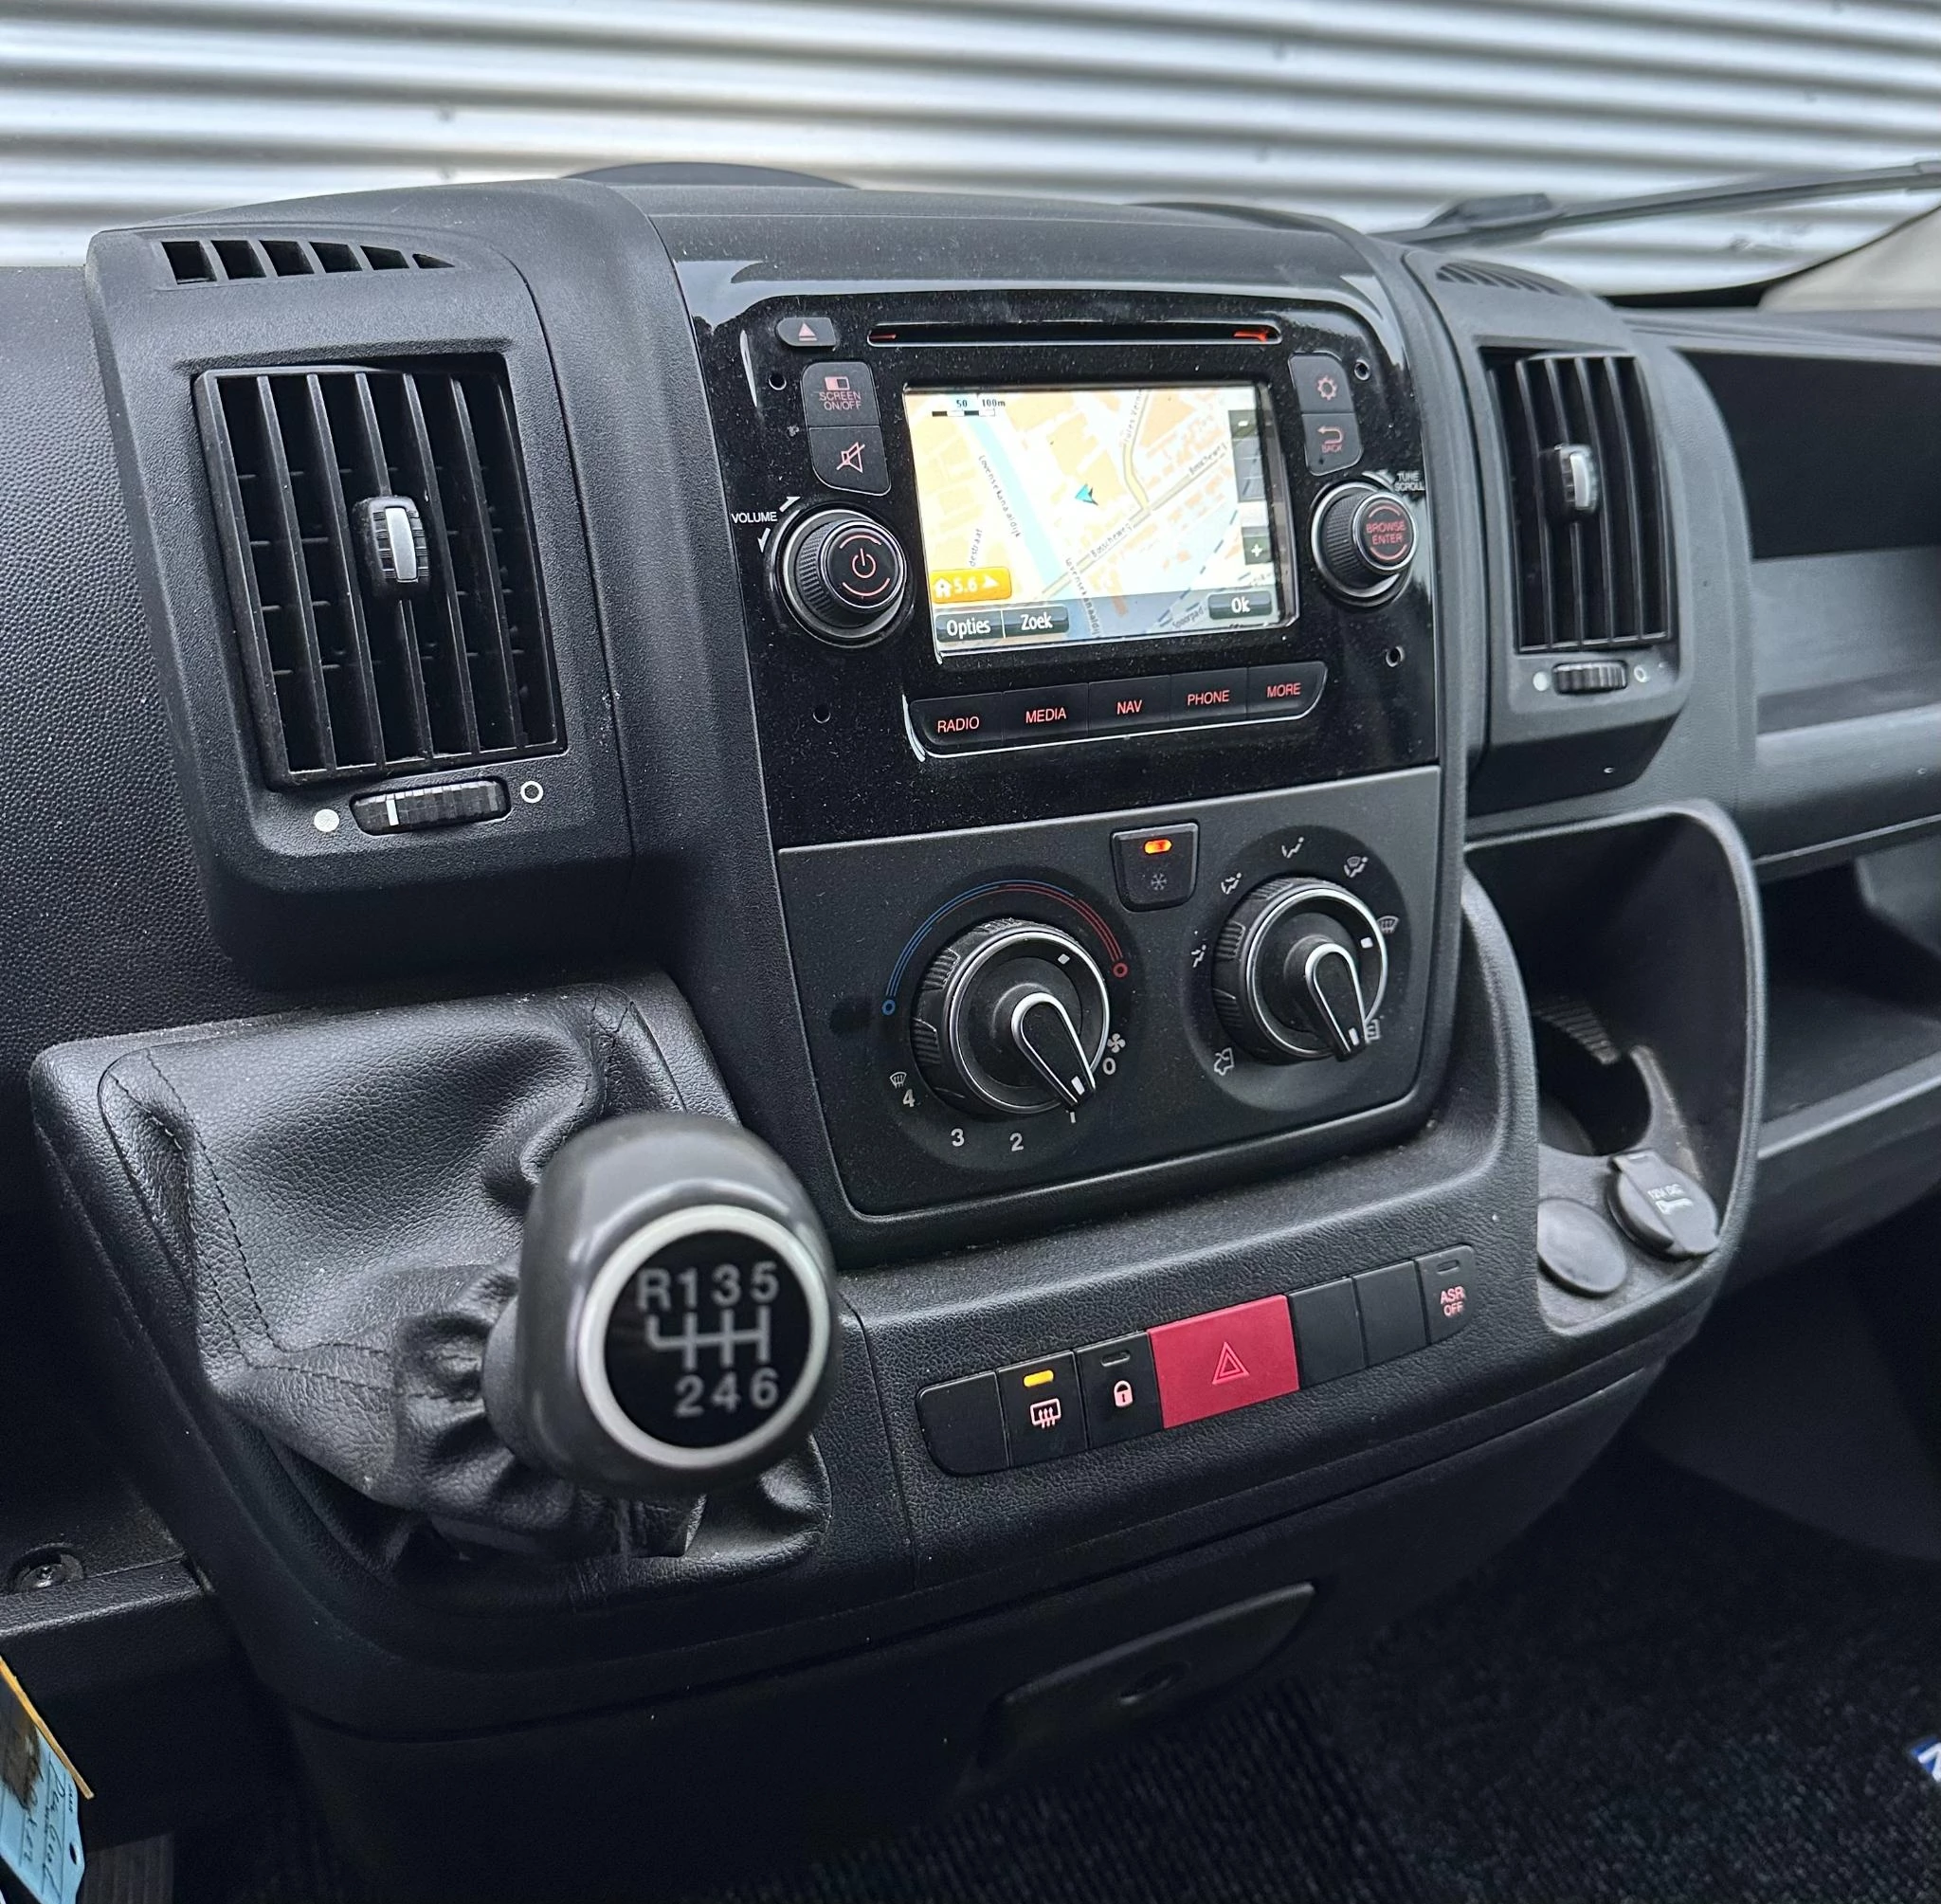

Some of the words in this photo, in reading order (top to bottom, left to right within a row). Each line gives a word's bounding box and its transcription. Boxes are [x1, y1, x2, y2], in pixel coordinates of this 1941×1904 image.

[819, 391, 862, 401] SCREEN
[982, 399, 1006, 408] 100m
[824, 401, 862, 411] ON/OFF
[1321, 444, 1342, 453] BACK
[731, 512, 778, 523] VOLUME
[1366, 521, 1406, 533] BROWSE
[1372, 534, 1403, 544] ENTER
[953, 576, 978, 594] 5.6
[1231, 596, 1251, 613] Ok
[947, 619, 991, 639] Opties
[1021, 612, 1054, 630] Zoek
[1187, 689, 1230, 706] PHONE
[1266, 682, 1301, 698] MORE
[1025, 706, 1067, 724] MEDIA
[1116, 699, 1143, 716] NAV
[937, 716, 980, 734] RADIO
[902, 1089, 916, 1108] 4
[951, 1128, 965, 1147] 3
[1009, 1133, 1025, 1151] 2
[636, 1267, 671, 1311] R
[677, 1267, 698, 1309] 1
[713, 1263, 741, 1306] 3
[750, 1260, 780, 1303] 5
[1441, 1285, 1466, 1304] ASR
[1443, 1301, 1463, 1316] OFF
[675, 1374, 704, 1418] 2
[712, 1371, 740, 1412] 4
[750, 1367, 779, 1408] 6
